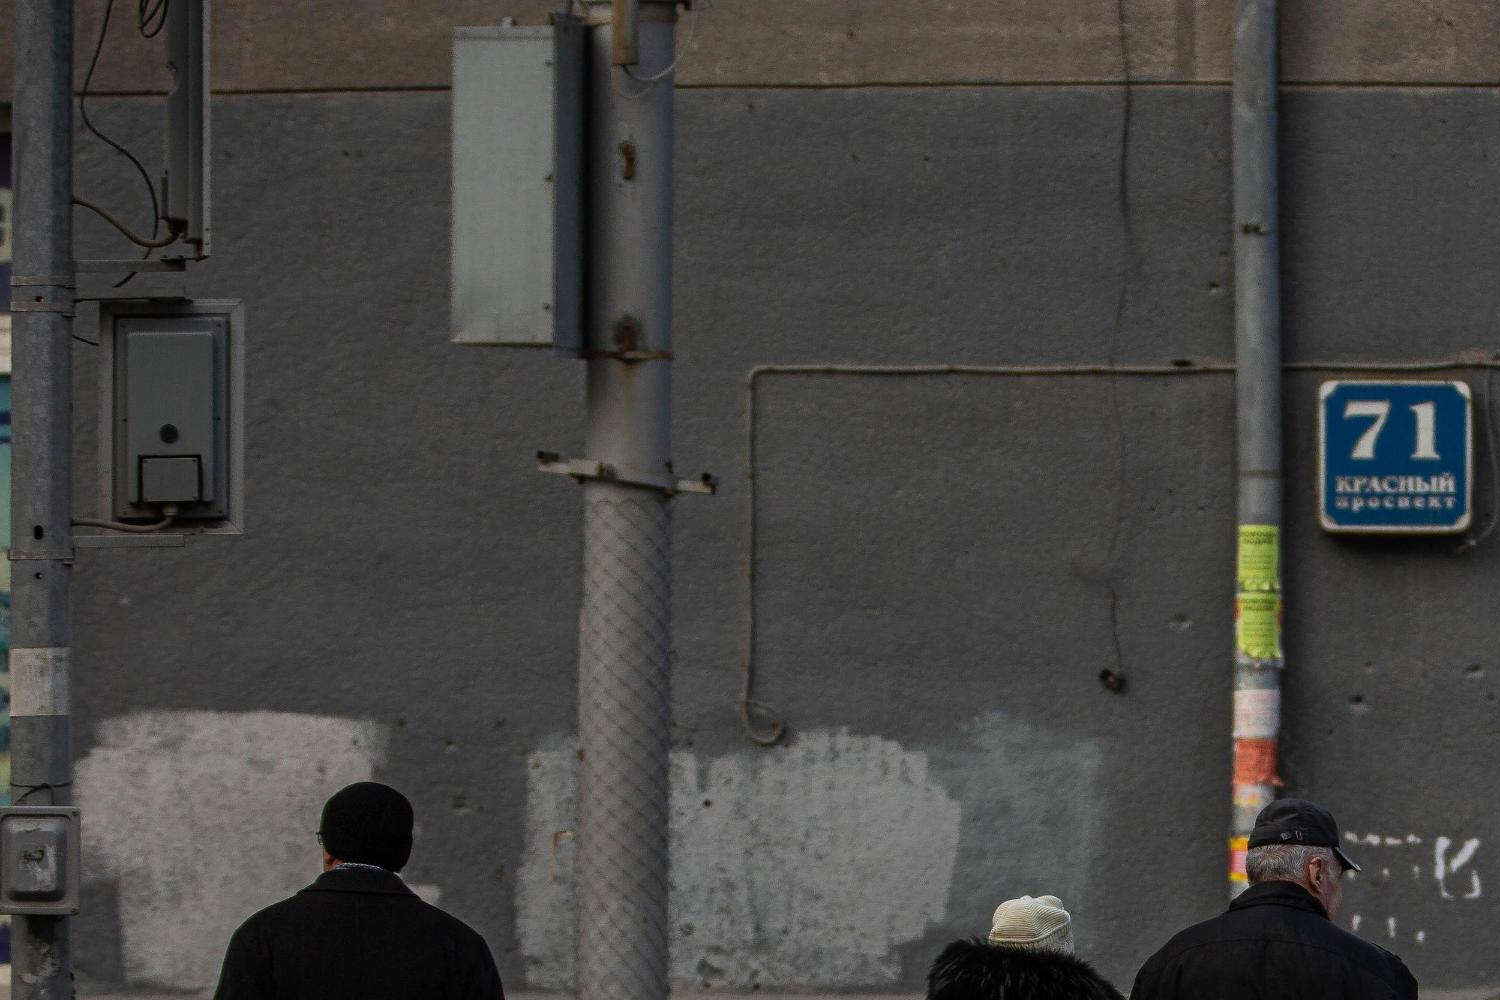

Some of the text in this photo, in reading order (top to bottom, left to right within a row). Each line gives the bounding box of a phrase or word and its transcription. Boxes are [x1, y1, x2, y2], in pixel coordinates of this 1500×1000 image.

[1343, 400, 1441, 460] 71
[1336, 472, 1456, 493] КРАСНЫЙ
[1336, 495, 1456, 511] проспект
